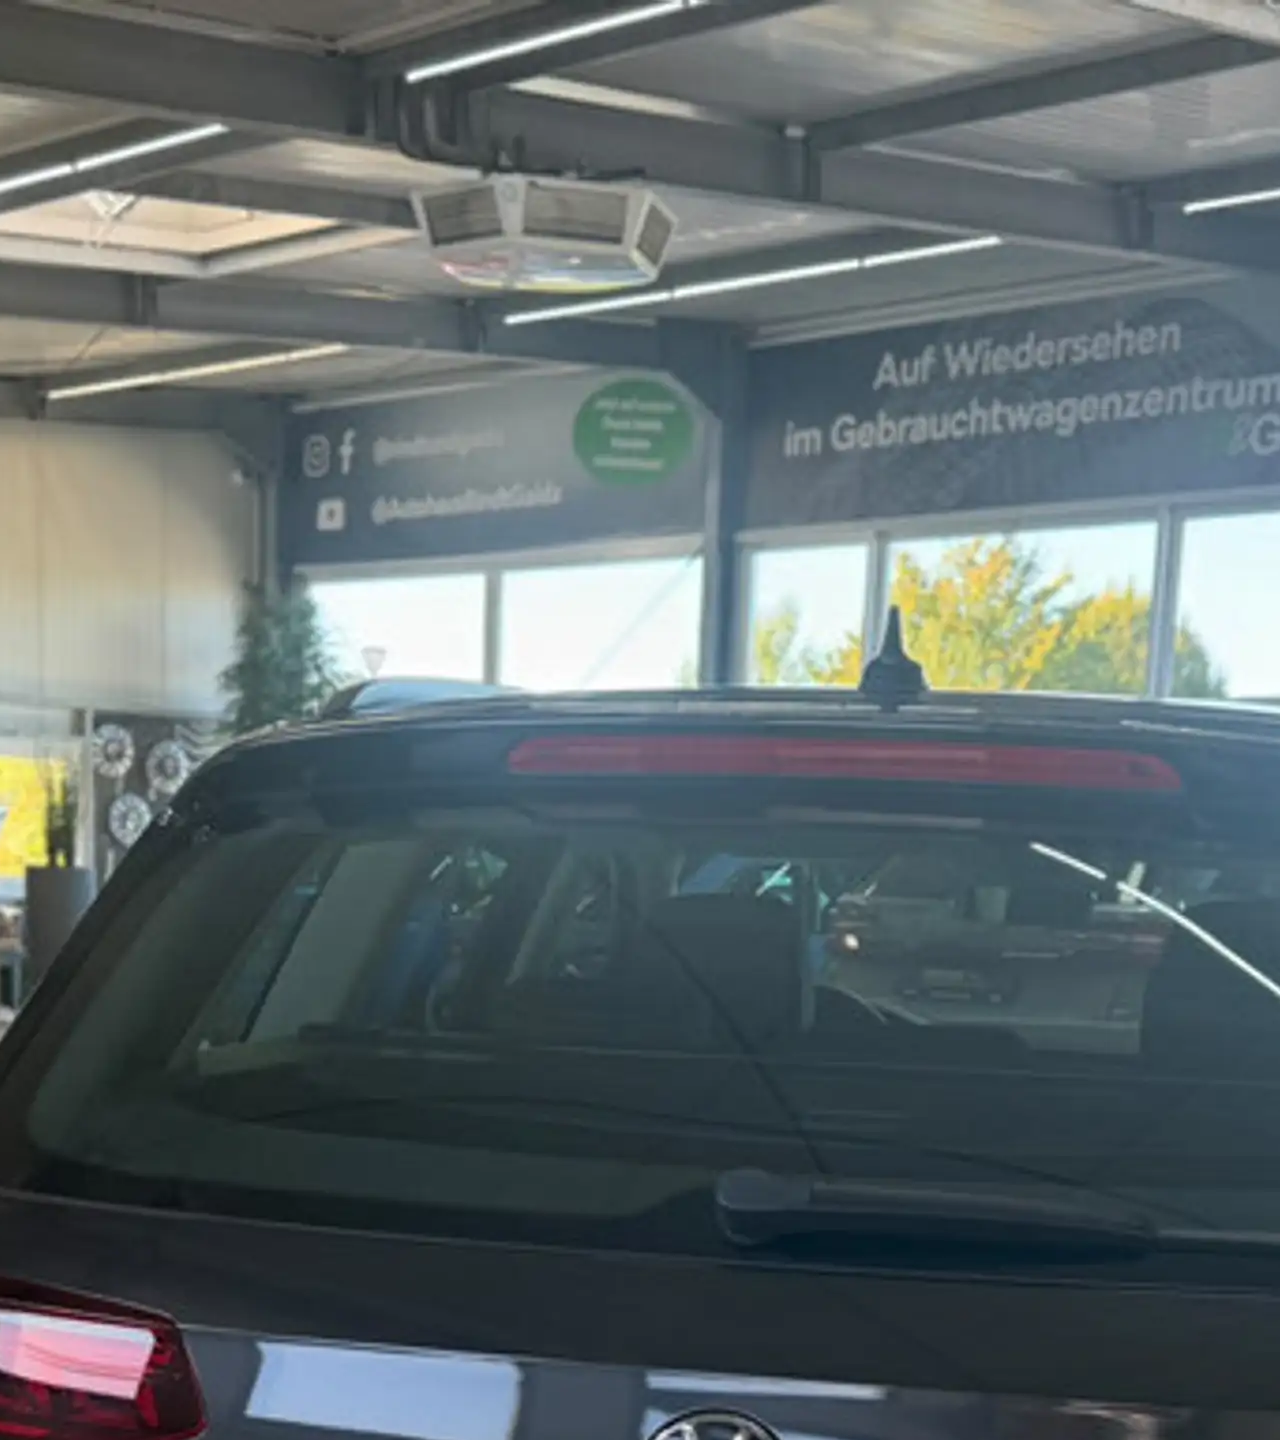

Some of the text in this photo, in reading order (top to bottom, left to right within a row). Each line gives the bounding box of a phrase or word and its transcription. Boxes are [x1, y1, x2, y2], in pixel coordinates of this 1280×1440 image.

[872, 319, 1181, 390] Auf Wiedersehen
[784, 419, 822, 458] im
